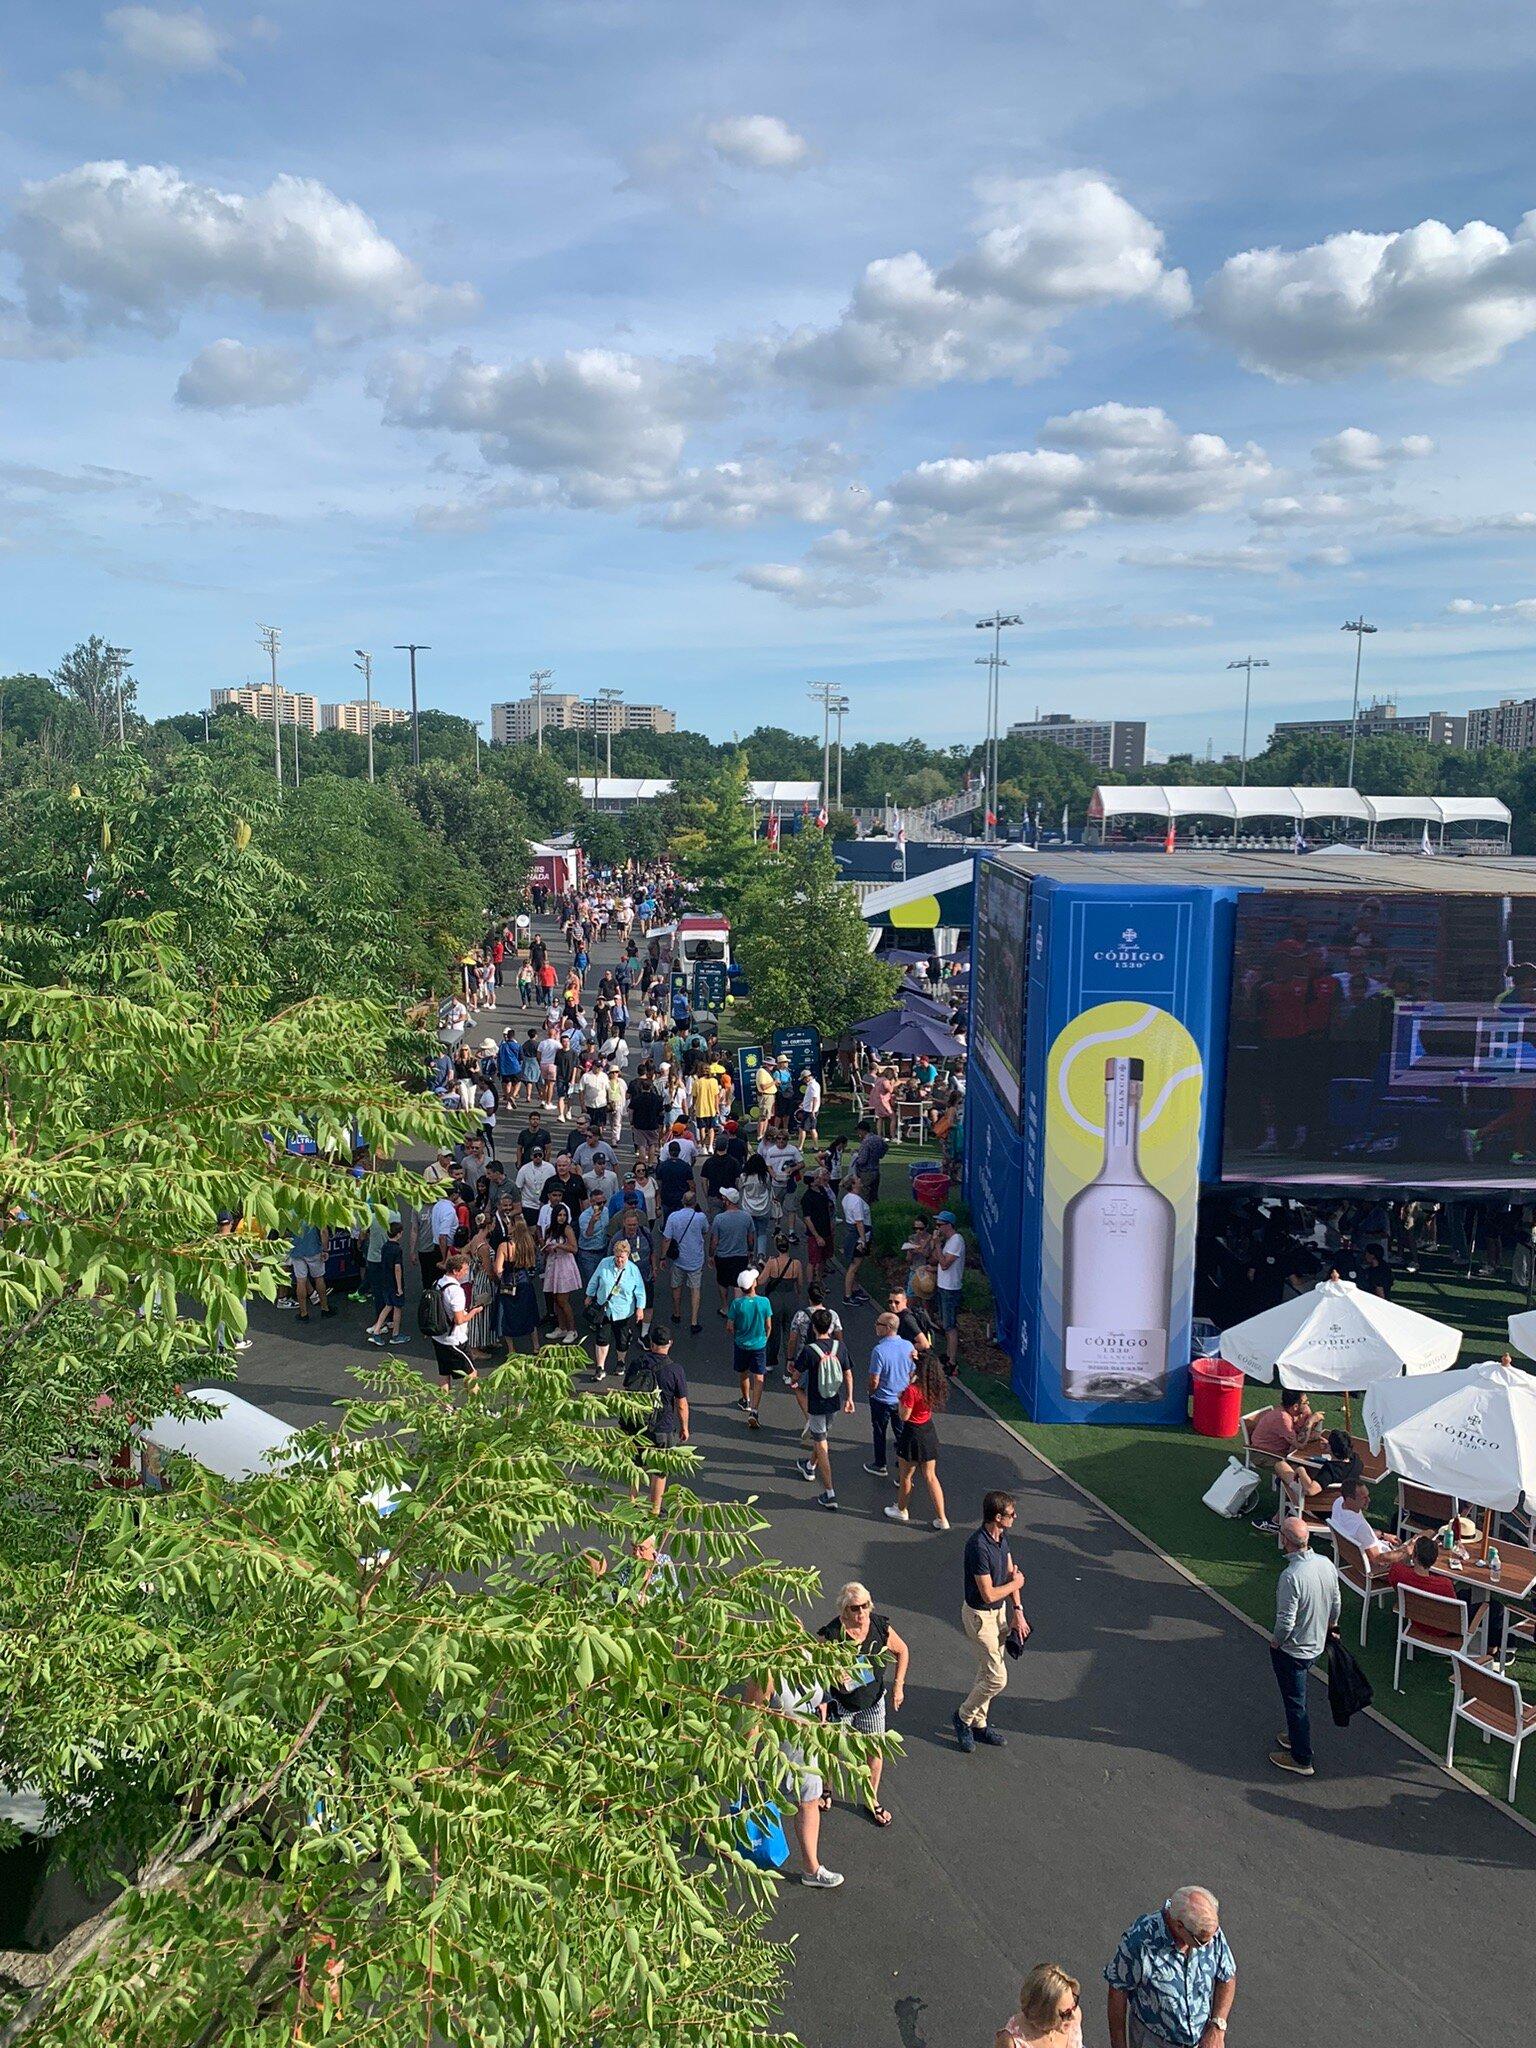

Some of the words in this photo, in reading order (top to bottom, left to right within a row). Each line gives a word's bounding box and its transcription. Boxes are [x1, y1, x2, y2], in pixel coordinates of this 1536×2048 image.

[1093, 949, 1164, 961] CÓDIGO
[1118, 1074, 1126, 1117] BLANCO
[1084, 1336, 1148, 1347] CÓDIGO
[1308, 1337, 1367, 1346] CÓDIGO
[1434, 1422, 1500, 1450] CÓDIGO
